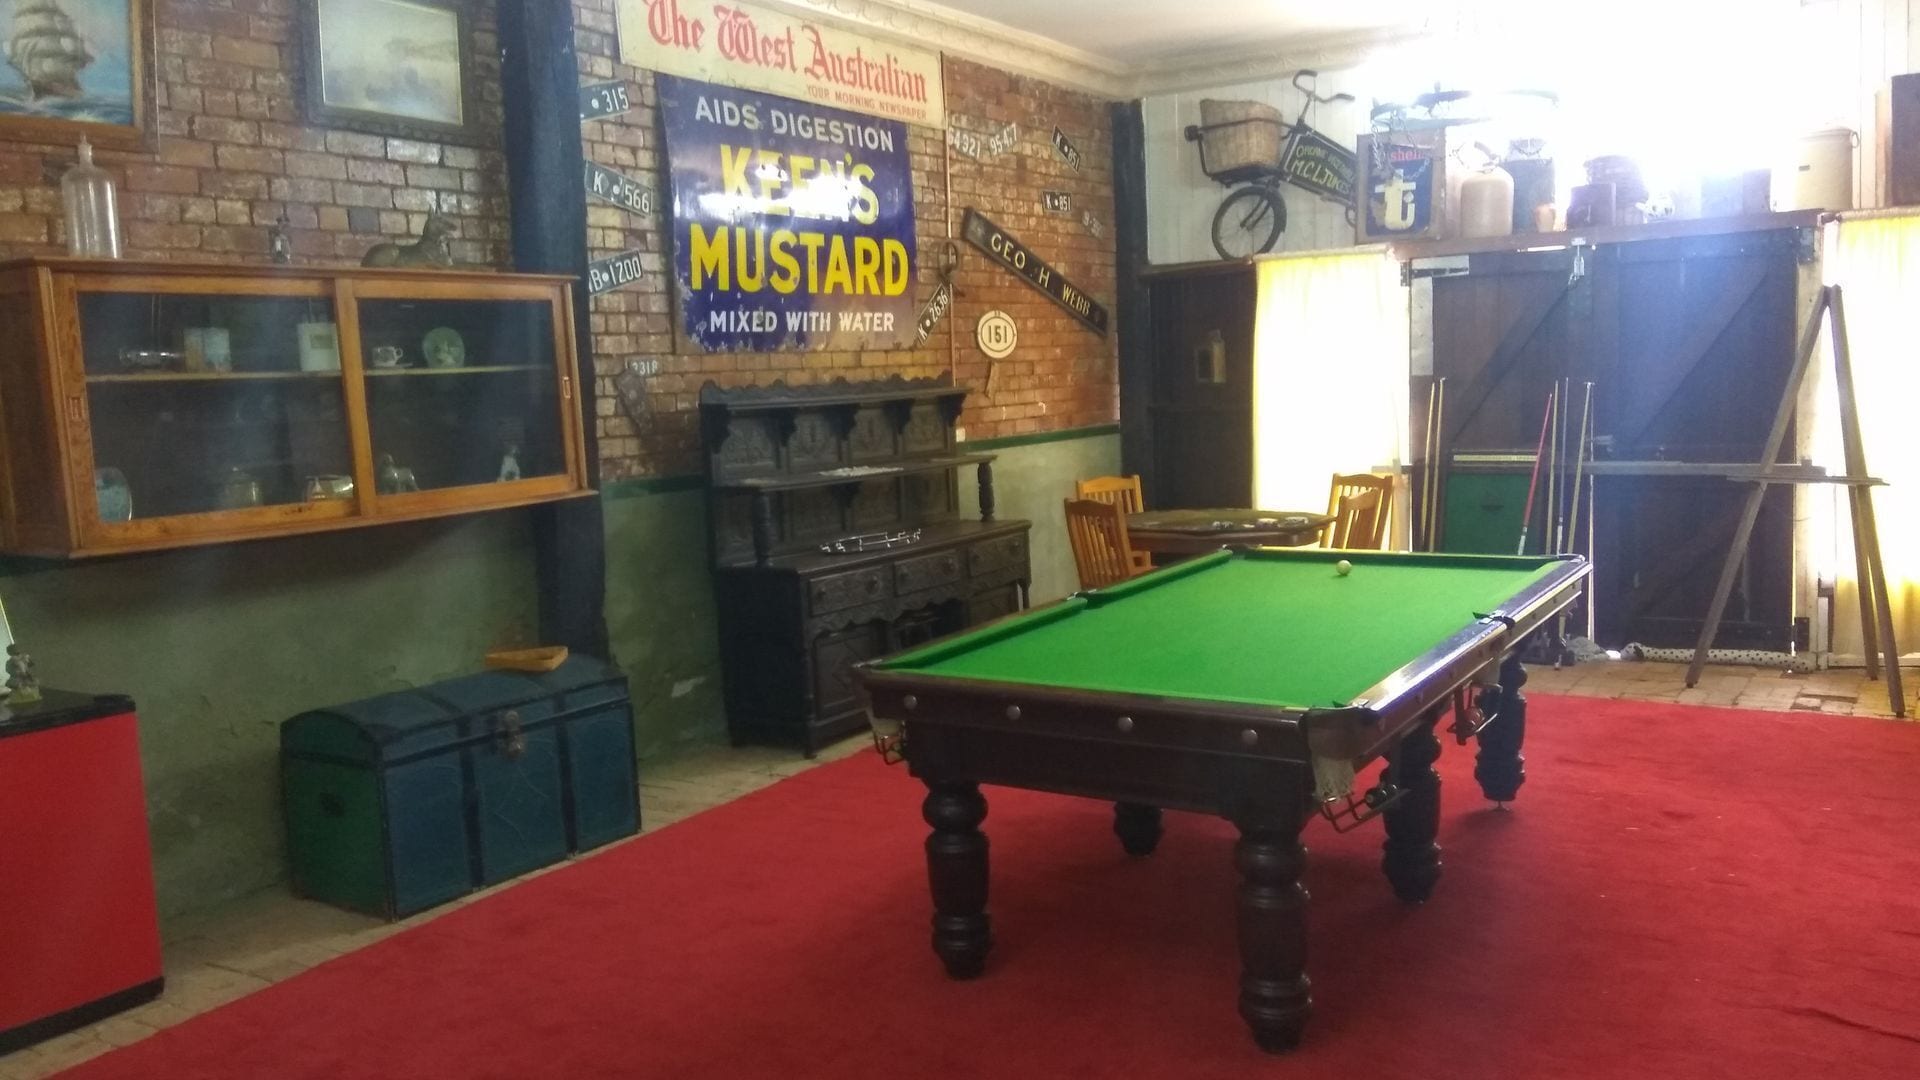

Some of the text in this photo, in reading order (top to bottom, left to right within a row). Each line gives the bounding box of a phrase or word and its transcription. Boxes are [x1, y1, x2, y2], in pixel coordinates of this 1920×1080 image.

[644, 0, 928, 104] The West Australian
[695, 96, 894, 153] AIDS DIGESTION
[806, 83, 927, 121] YOUR MORNING NEWSPAPER
[720, 144, 880, 226] KEEN'S
[689, 223, 909, 297] MUSTARD
[710, 310, 895, 333] MIXED WITH WATER
[1062, 283, 1091, 317] WEBB
[988, 324, 1008, 344] 151
